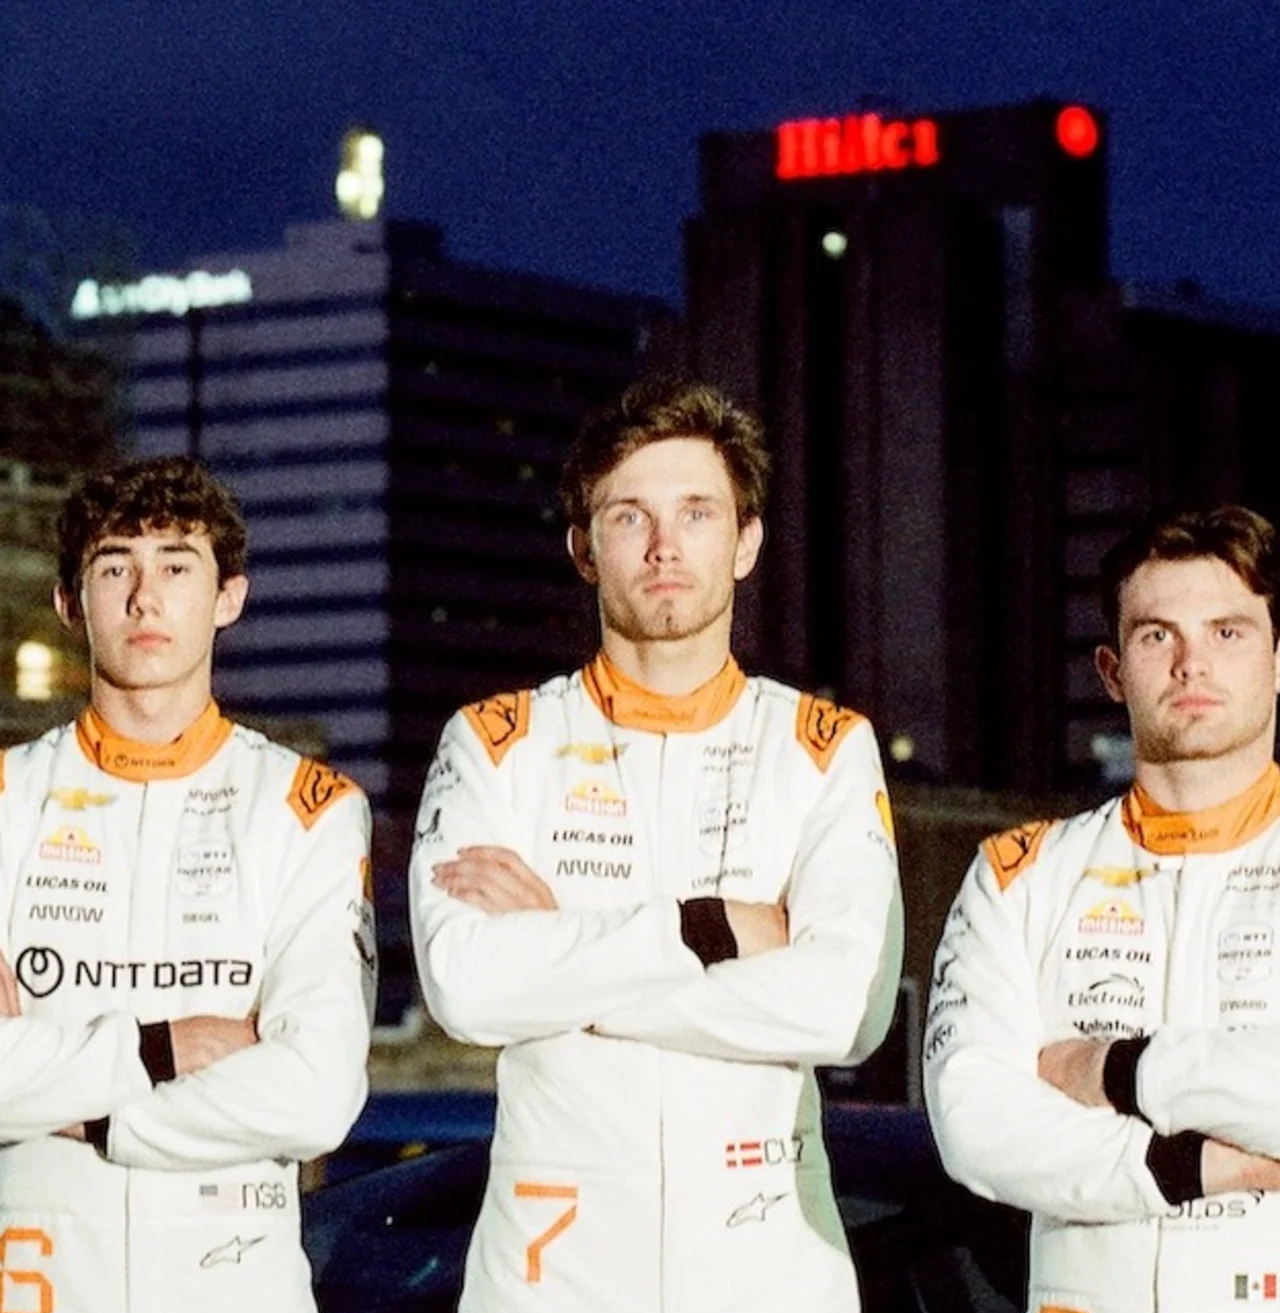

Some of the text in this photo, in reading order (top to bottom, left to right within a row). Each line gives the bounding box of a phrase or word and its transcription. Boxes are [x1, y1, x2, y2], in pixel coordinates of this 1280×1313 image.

[553, 830, 634, 846] LUCAS OIL
[26, 875, 108, 893] LUCAS OIL
[1065, 947, 1152, 963] LUCAS OIL
[75, 960, 146, 989] NTT
[514, 1181, 579, 1284] 7
